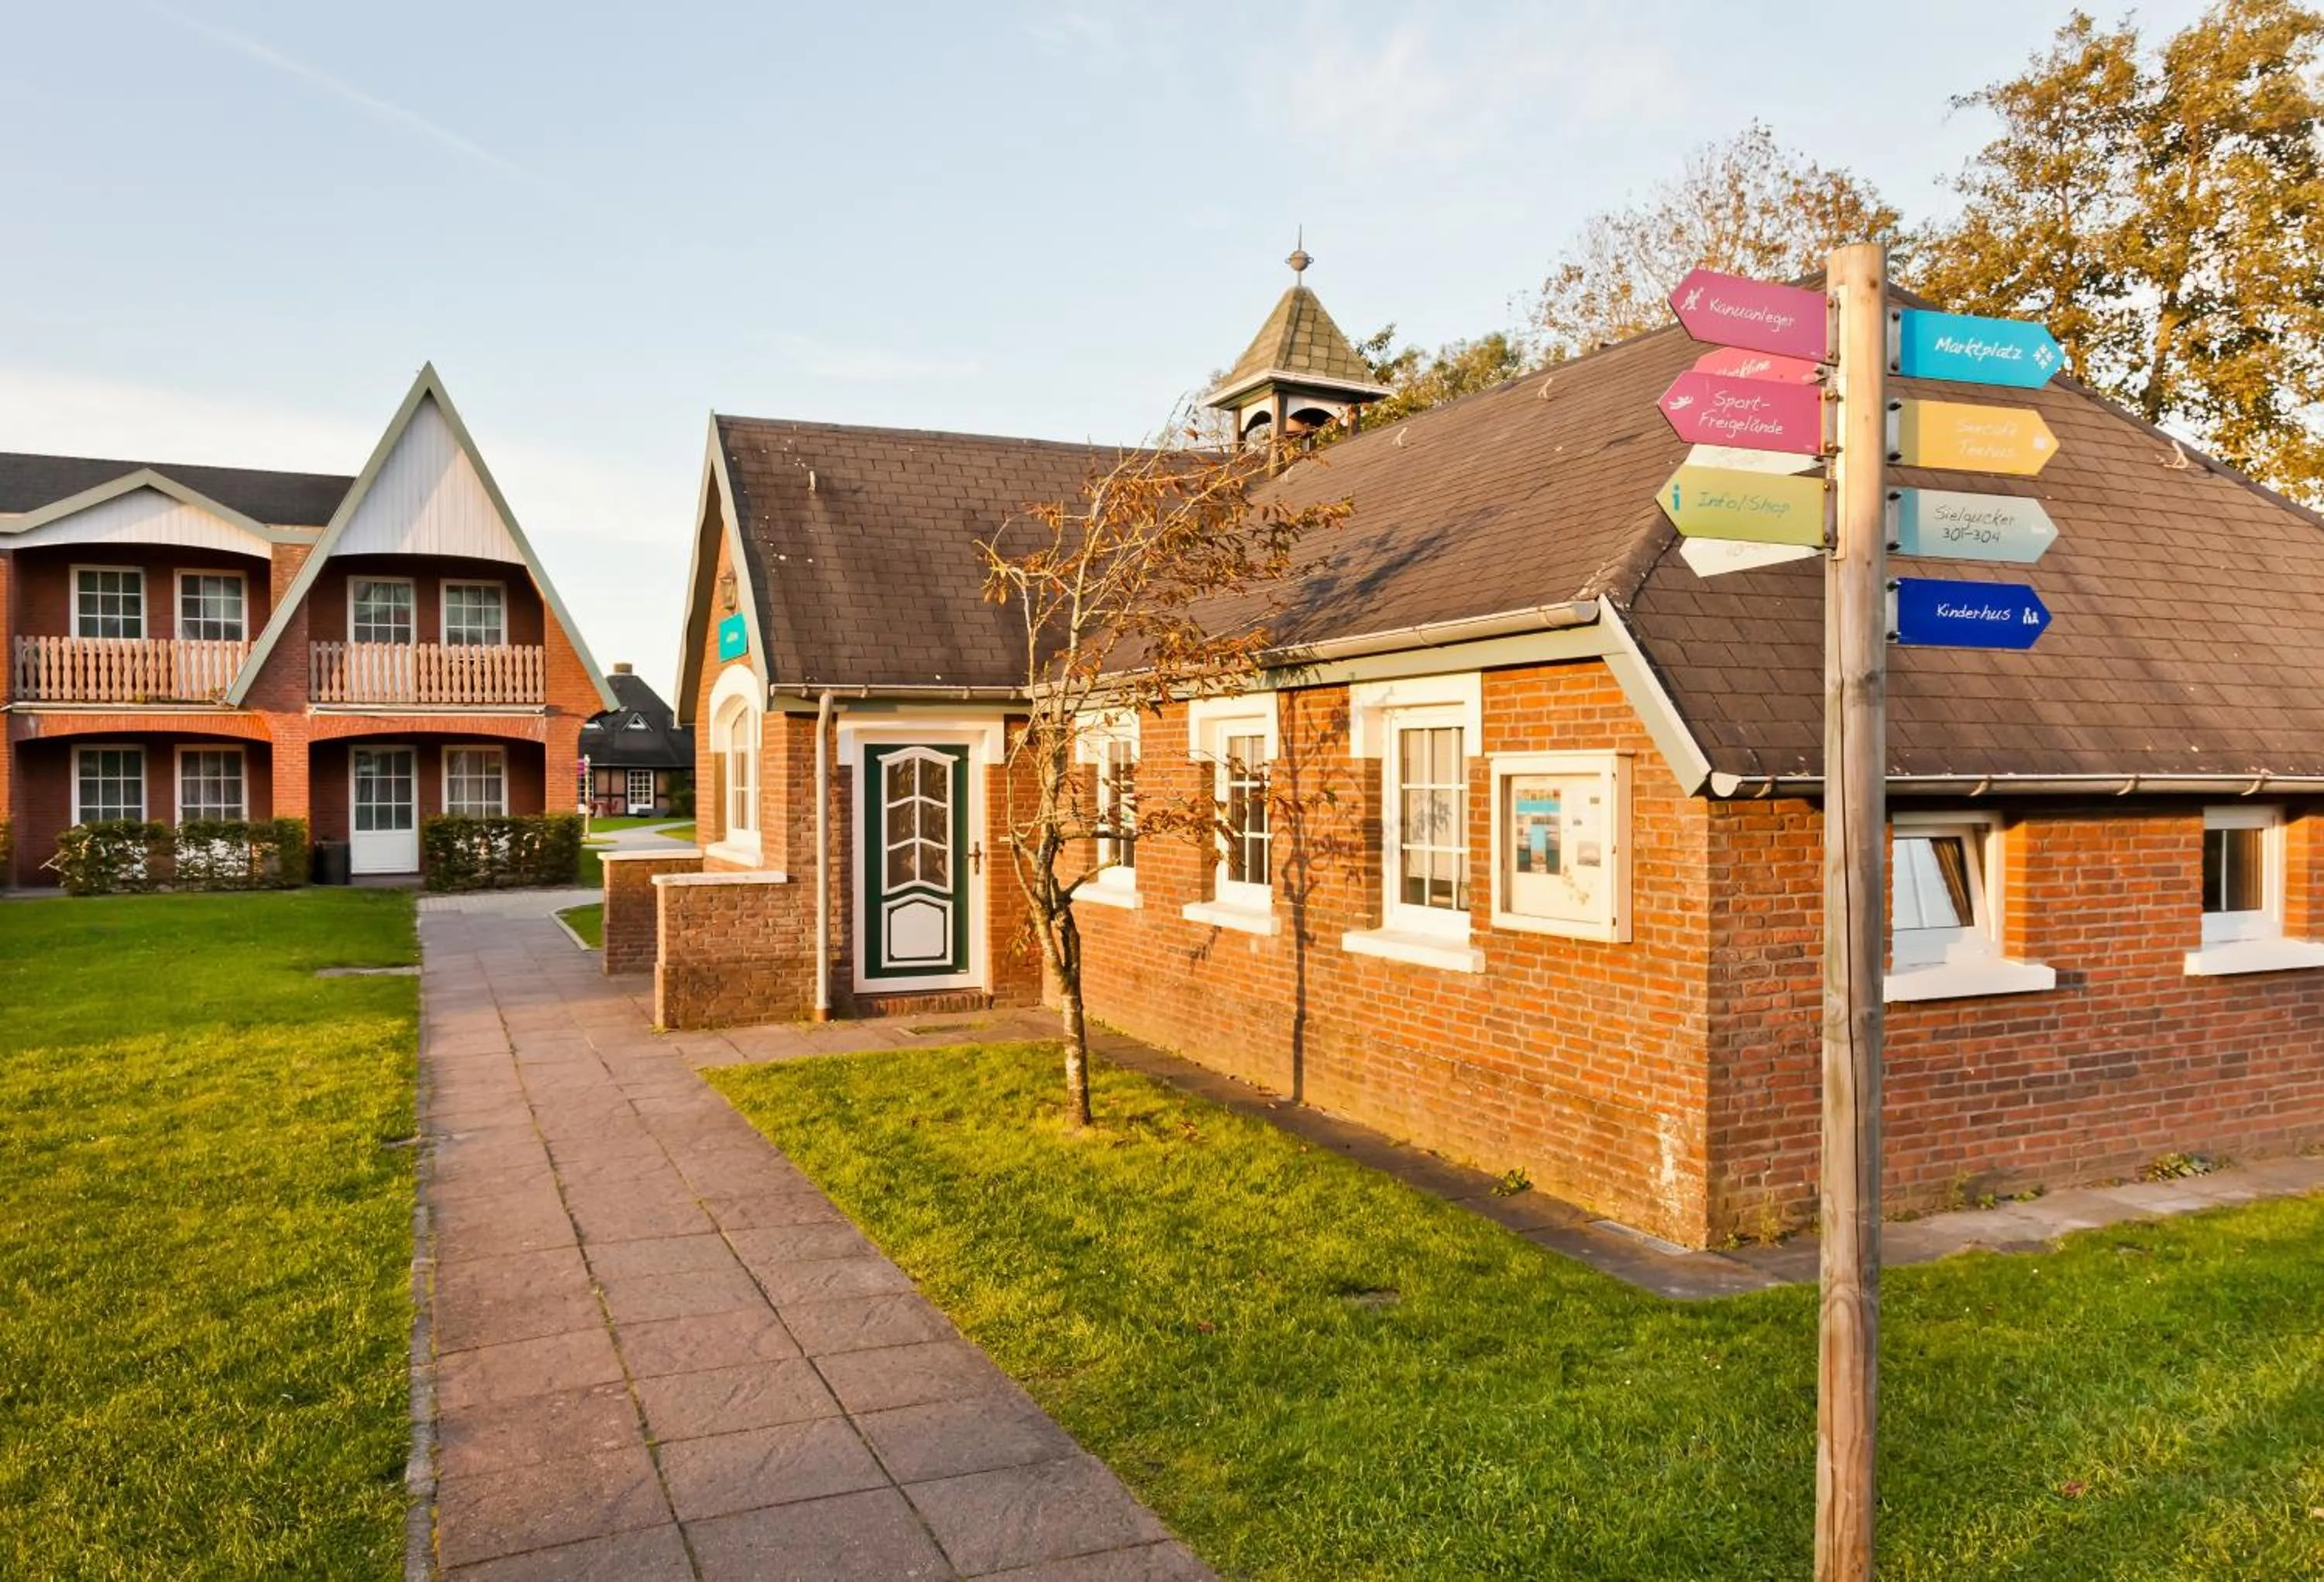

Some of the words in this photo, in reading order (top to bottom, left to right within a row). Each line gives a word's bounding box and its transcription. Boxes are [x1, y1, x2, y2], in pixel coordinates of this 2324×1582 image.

[1709, 298, 1795, 332] Kanuanleger
[1934, 336, 2023, 362] Marktplatz
[1713, 390, 1771, 413] Sport-
[1698, 408, 1784, 438] Freigelände
[1933, 504, 2016, 531] Sielgucker
[1937, 604, 2012, 621] Kinderhus
